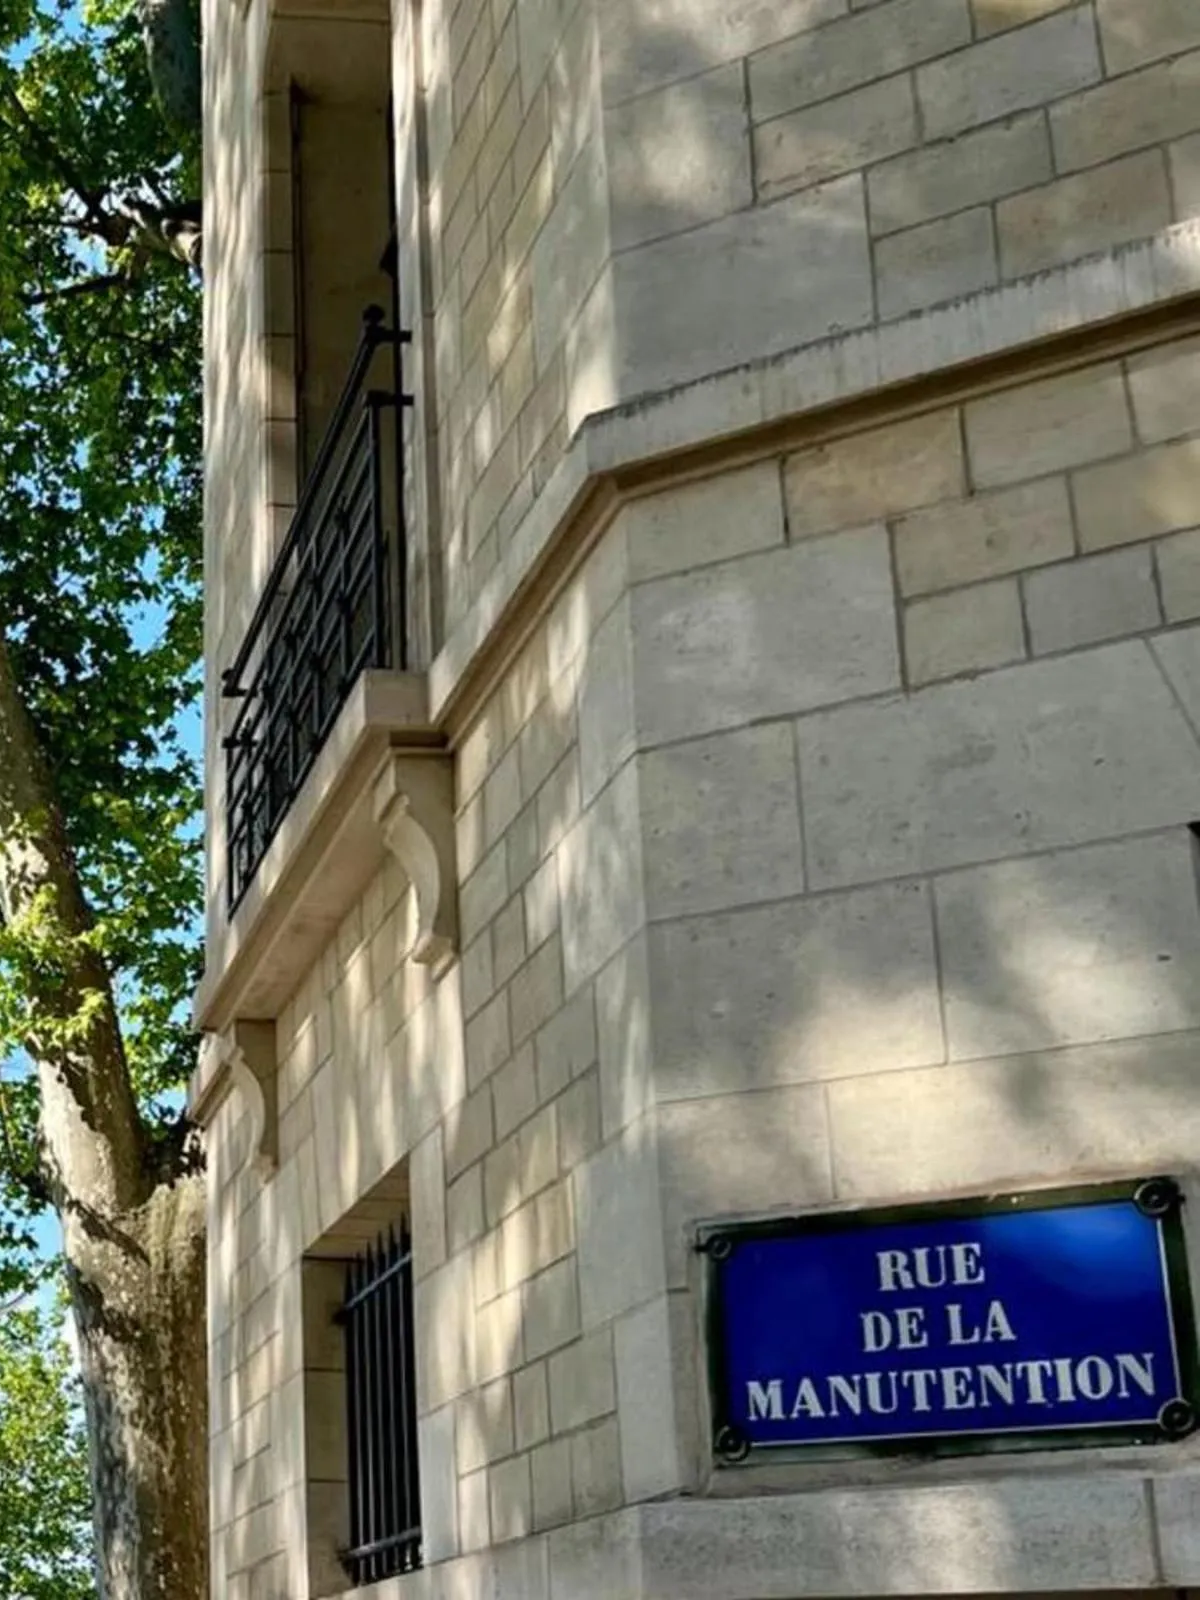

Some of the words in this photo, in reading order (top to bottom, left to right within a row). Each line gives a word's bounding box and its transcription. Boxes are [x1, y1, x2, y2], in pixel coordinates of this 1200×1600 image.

[877, 1242, 985, 1291] RUE
[861, 1307, 929, 1352] DE
[947, 1301, 1017, 1345] LA
[747, 1353, 1155, 1421] MANUTENTION
